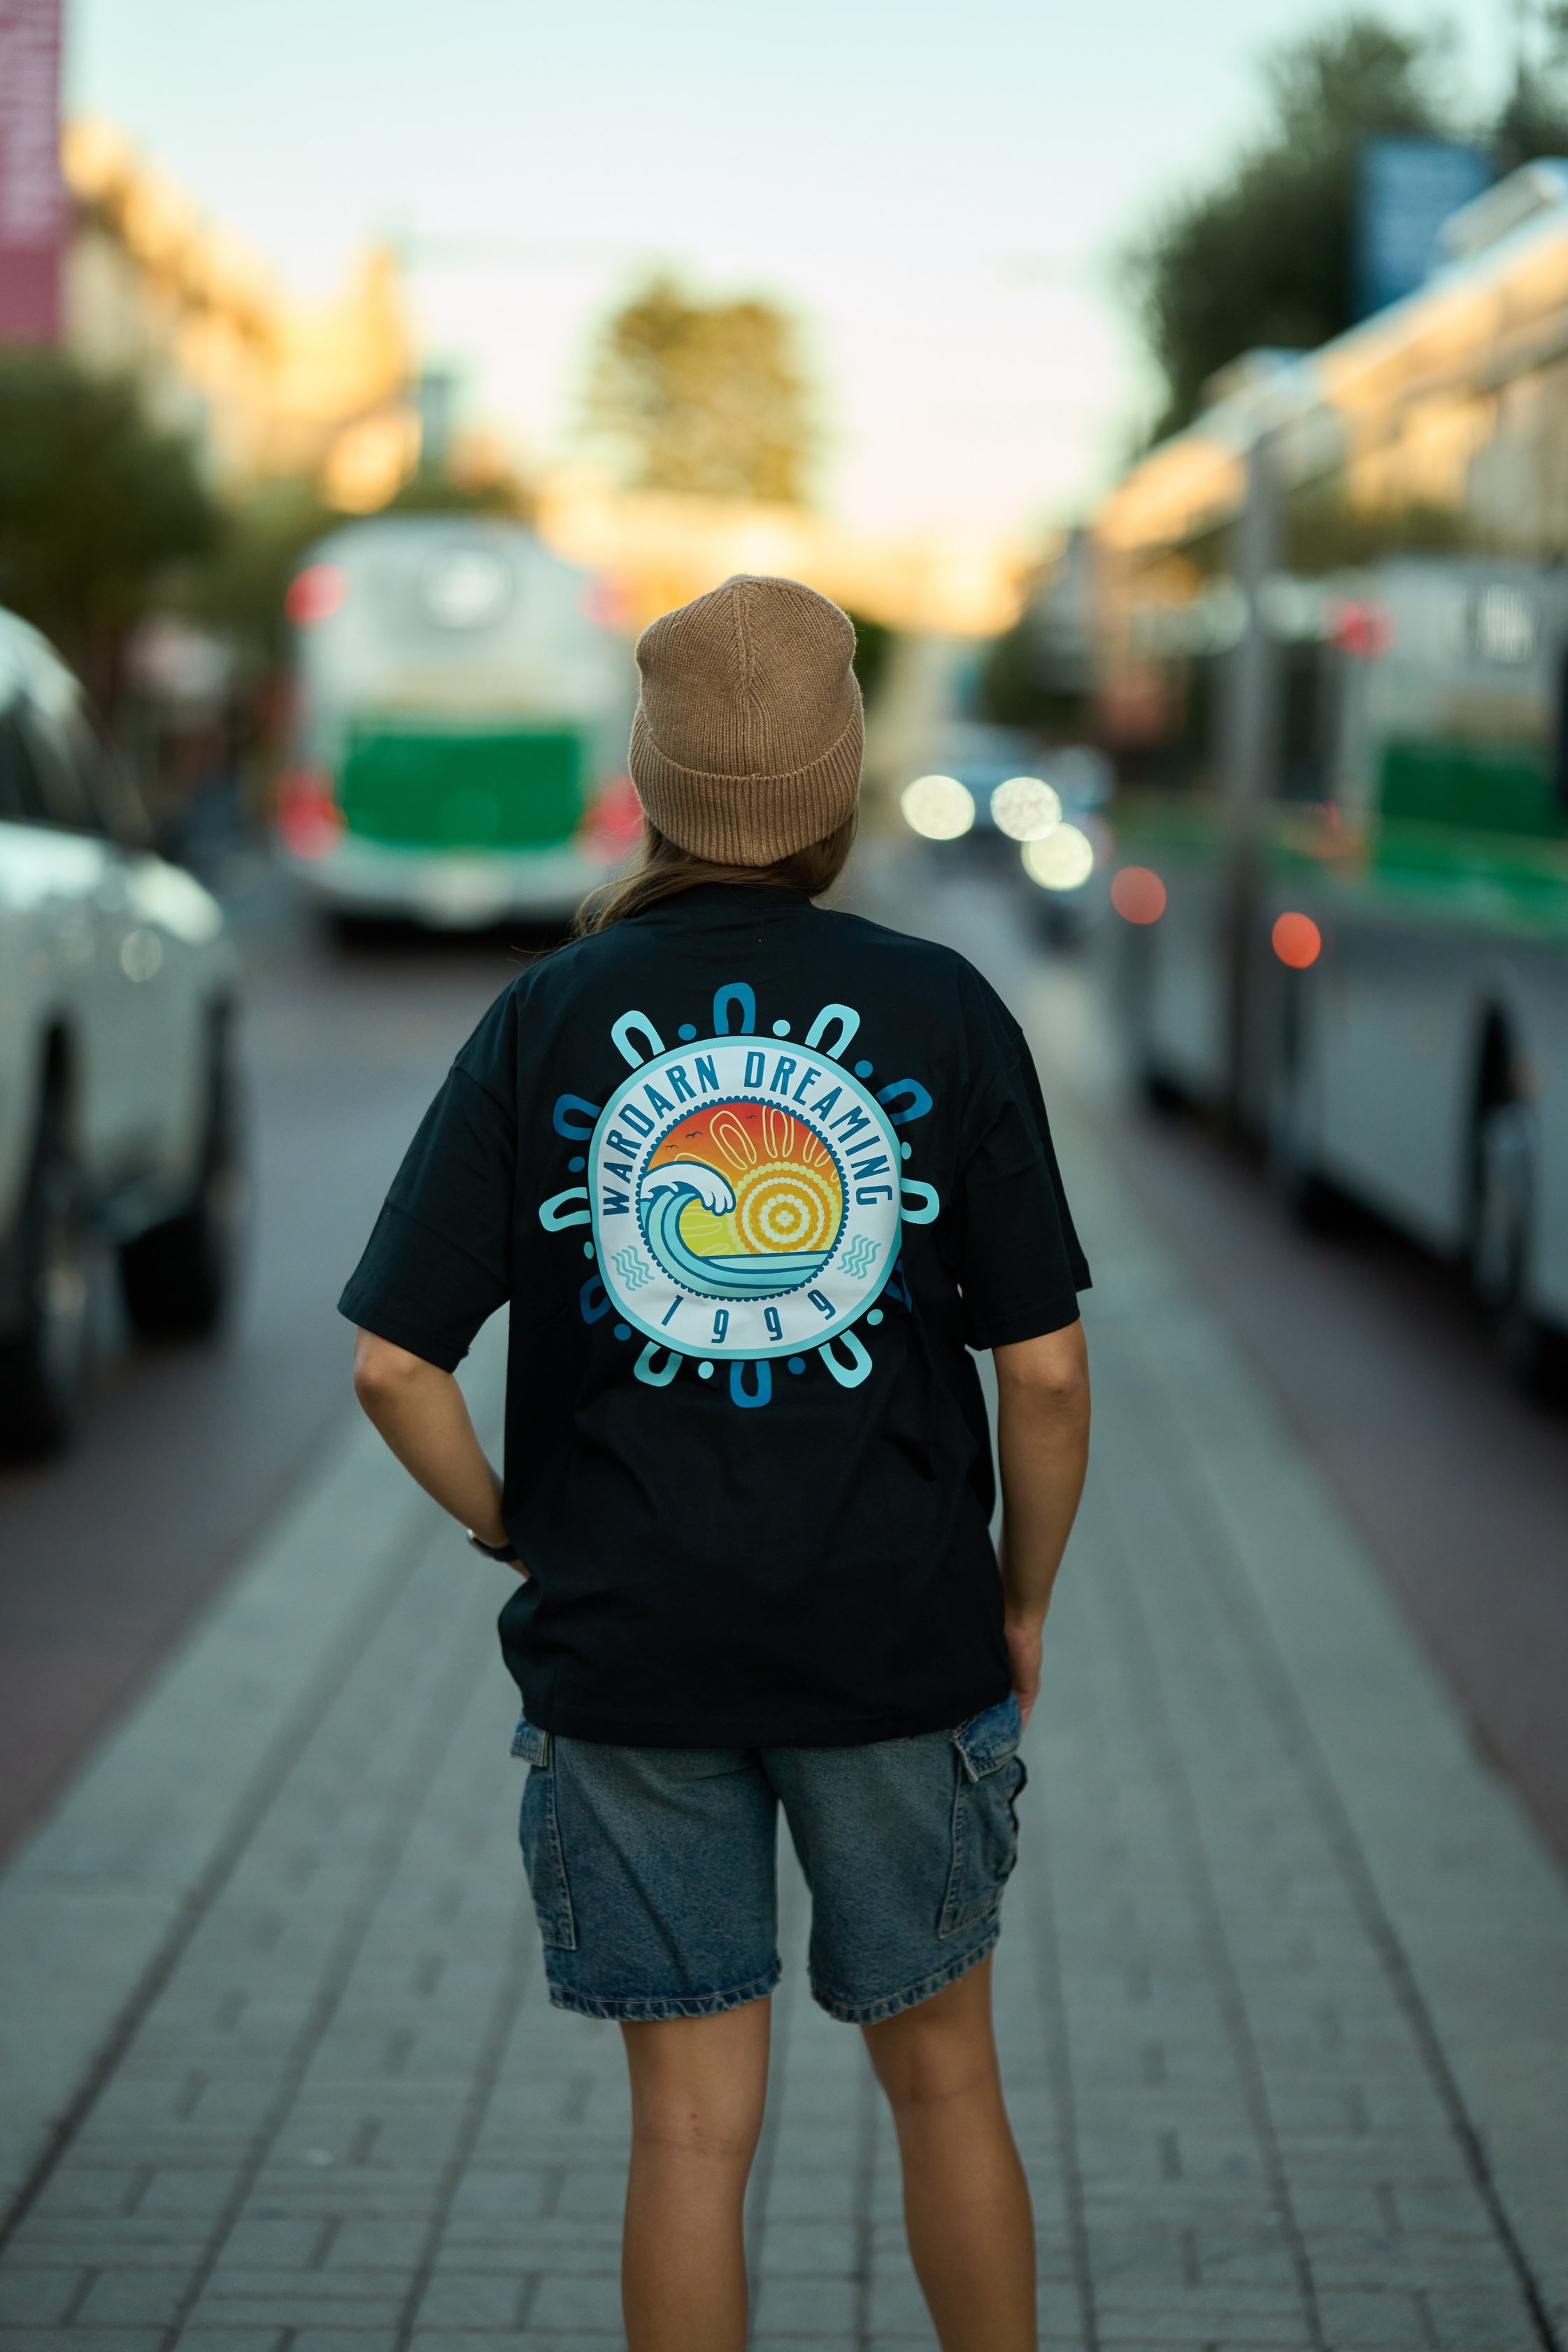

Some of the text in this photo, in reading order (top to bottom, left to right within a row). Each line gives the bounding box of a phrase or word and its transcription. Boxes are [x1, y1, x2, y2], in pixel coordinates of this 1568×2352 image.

[603, 1052, 892, 1216] WARDARN DREAMING
[662, 1290, 836, 1343] 1999
